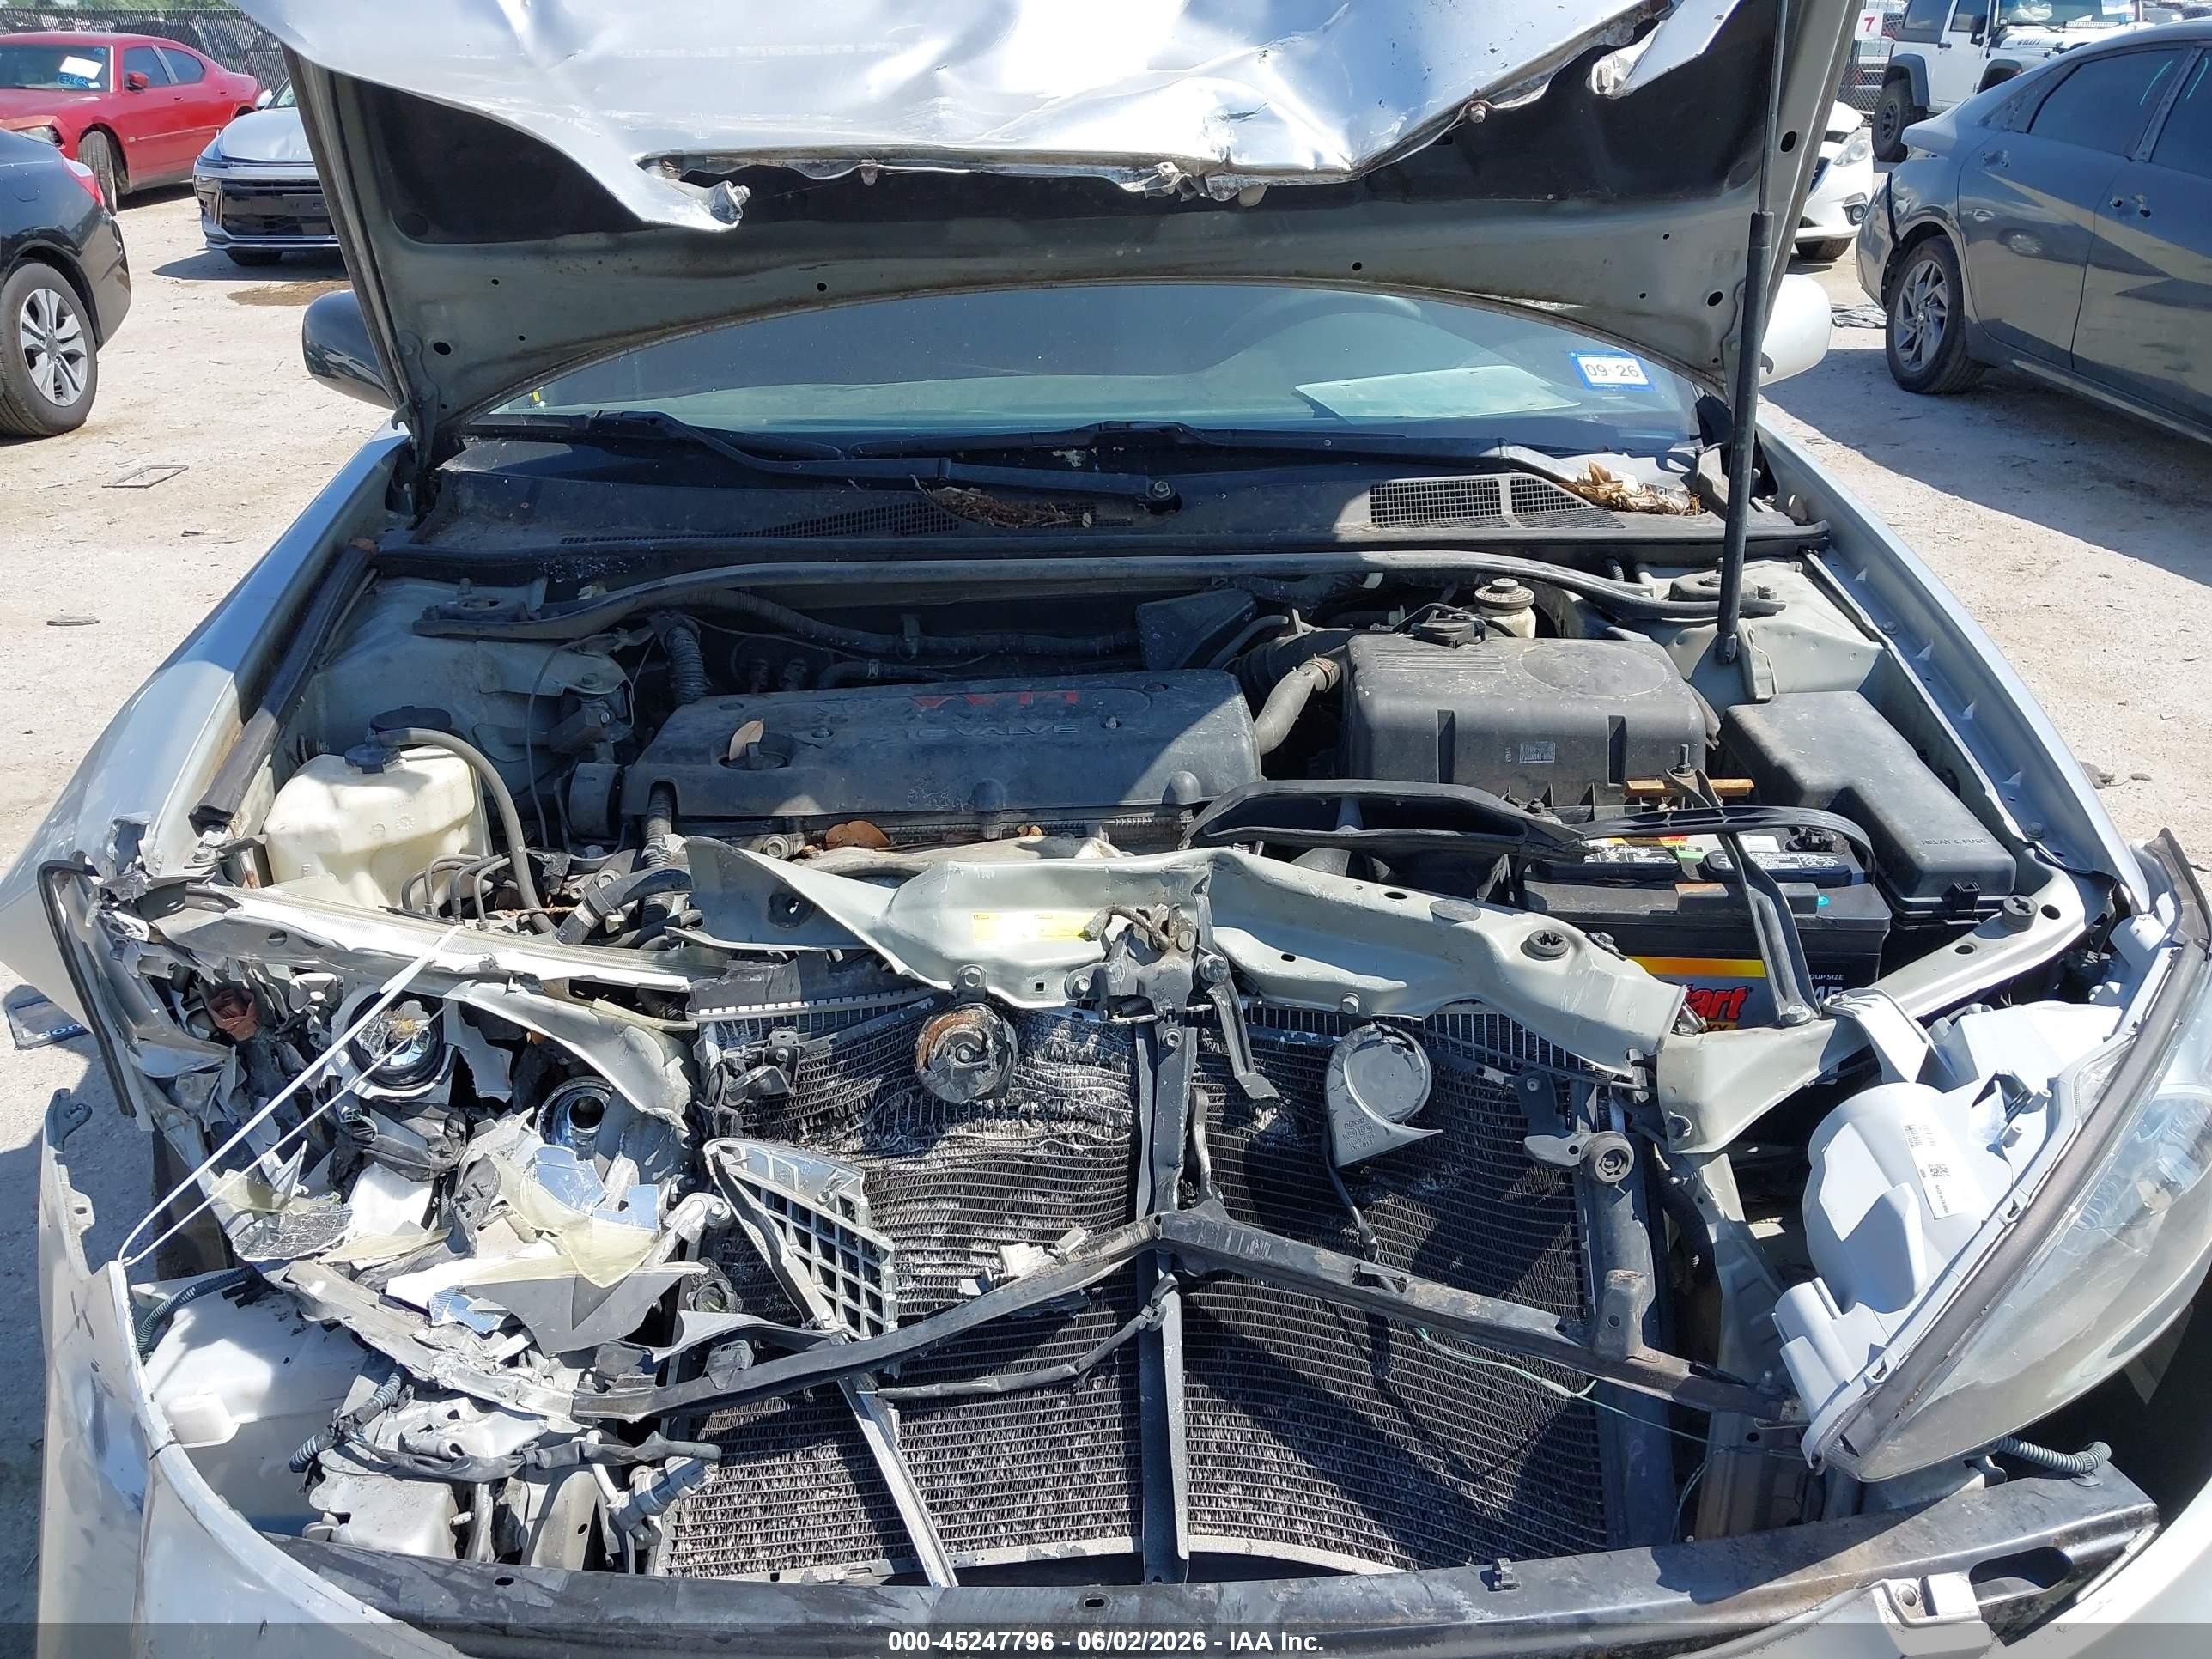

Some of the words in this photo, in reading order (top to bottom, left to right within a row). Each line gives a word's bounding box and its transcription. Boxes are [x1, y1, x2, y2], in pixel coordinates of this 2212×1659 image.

[1864, 16, 1875, 32] 7
[1585, 364, 1607, 376] 09
[1616, 365, 1638, 377] 26
